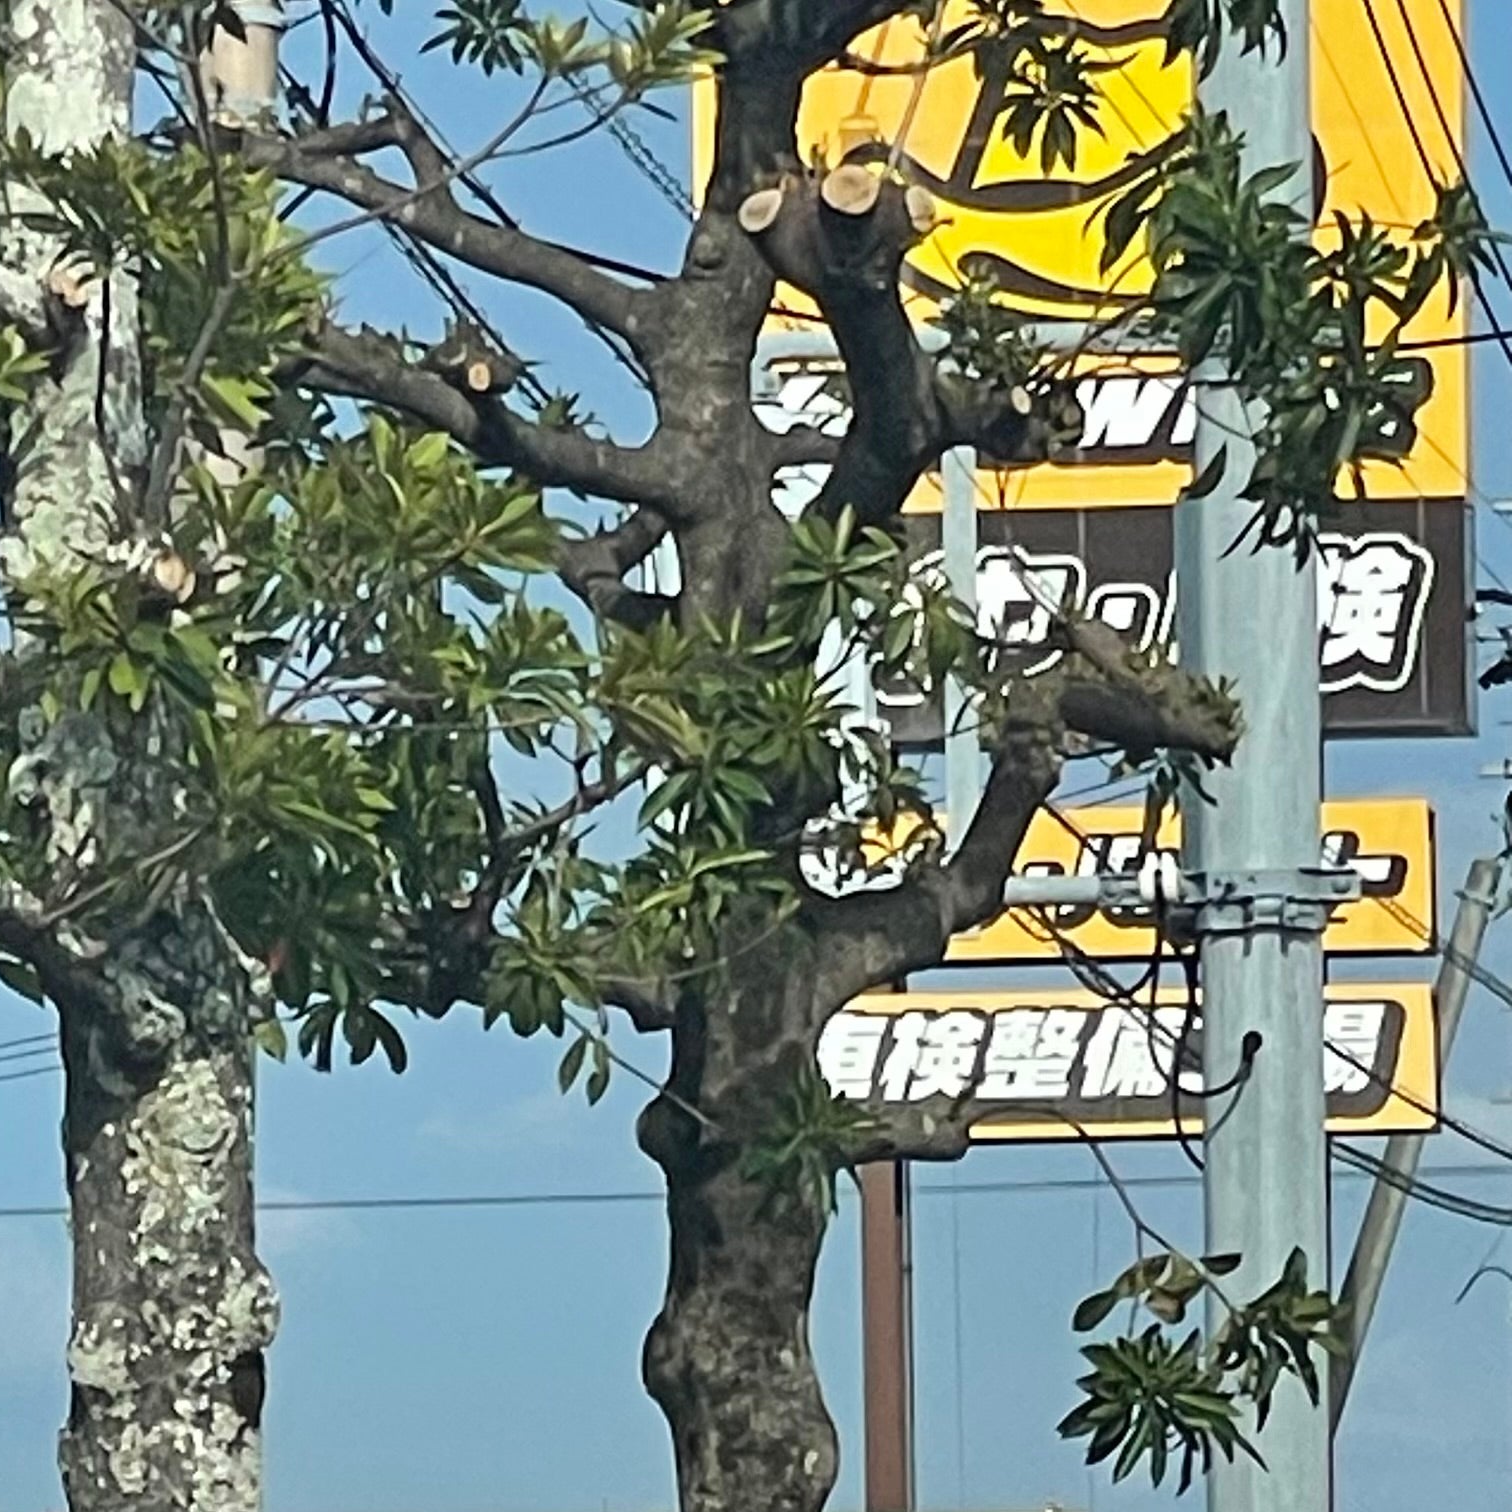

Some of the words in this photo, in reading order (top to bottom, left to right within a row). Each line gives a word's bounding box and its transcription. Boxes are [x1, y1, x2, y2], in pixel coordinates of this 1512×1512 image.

[817, 1001, 1385, 1101] 車検整備場
